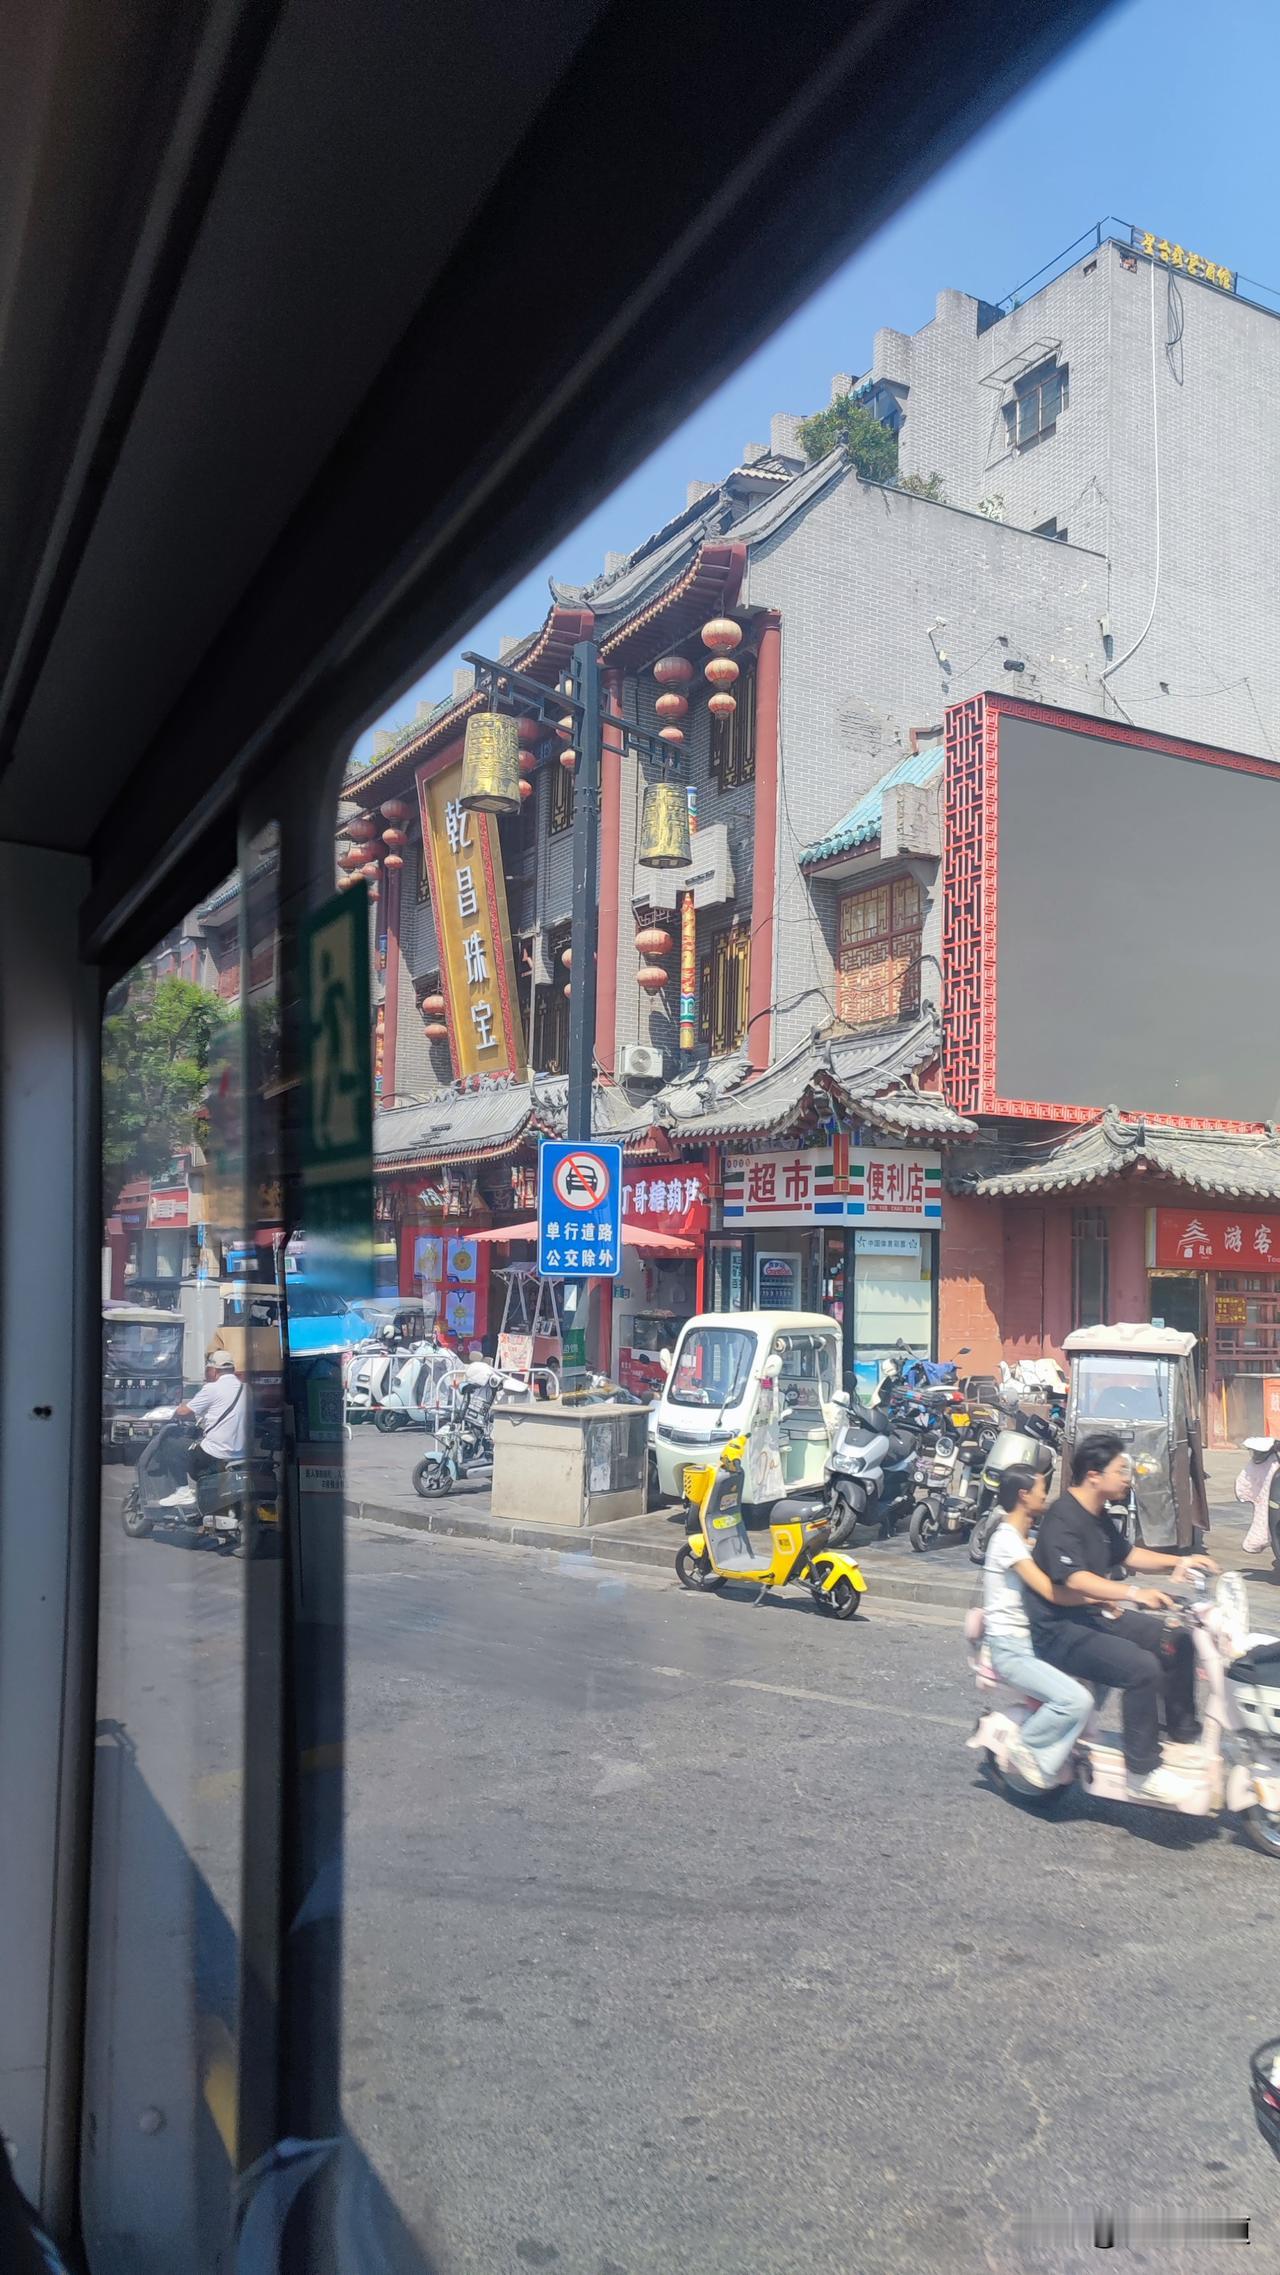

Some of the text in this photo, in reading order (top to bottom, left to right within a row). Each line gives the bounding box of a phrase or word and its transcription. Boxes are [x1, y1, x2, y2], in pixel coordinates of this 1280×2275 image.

[444, 799, 498, 1051] 乾昌珠宝
[748, 1159, 812, 1202] 超市
[866, 1161, 923, 1203] 便利店
[546, 1221, 612, 1242] 单行道路
[1224, 1224, 1272, 1255] 游客
[546, 1249, 613, 1268] 公交除外
